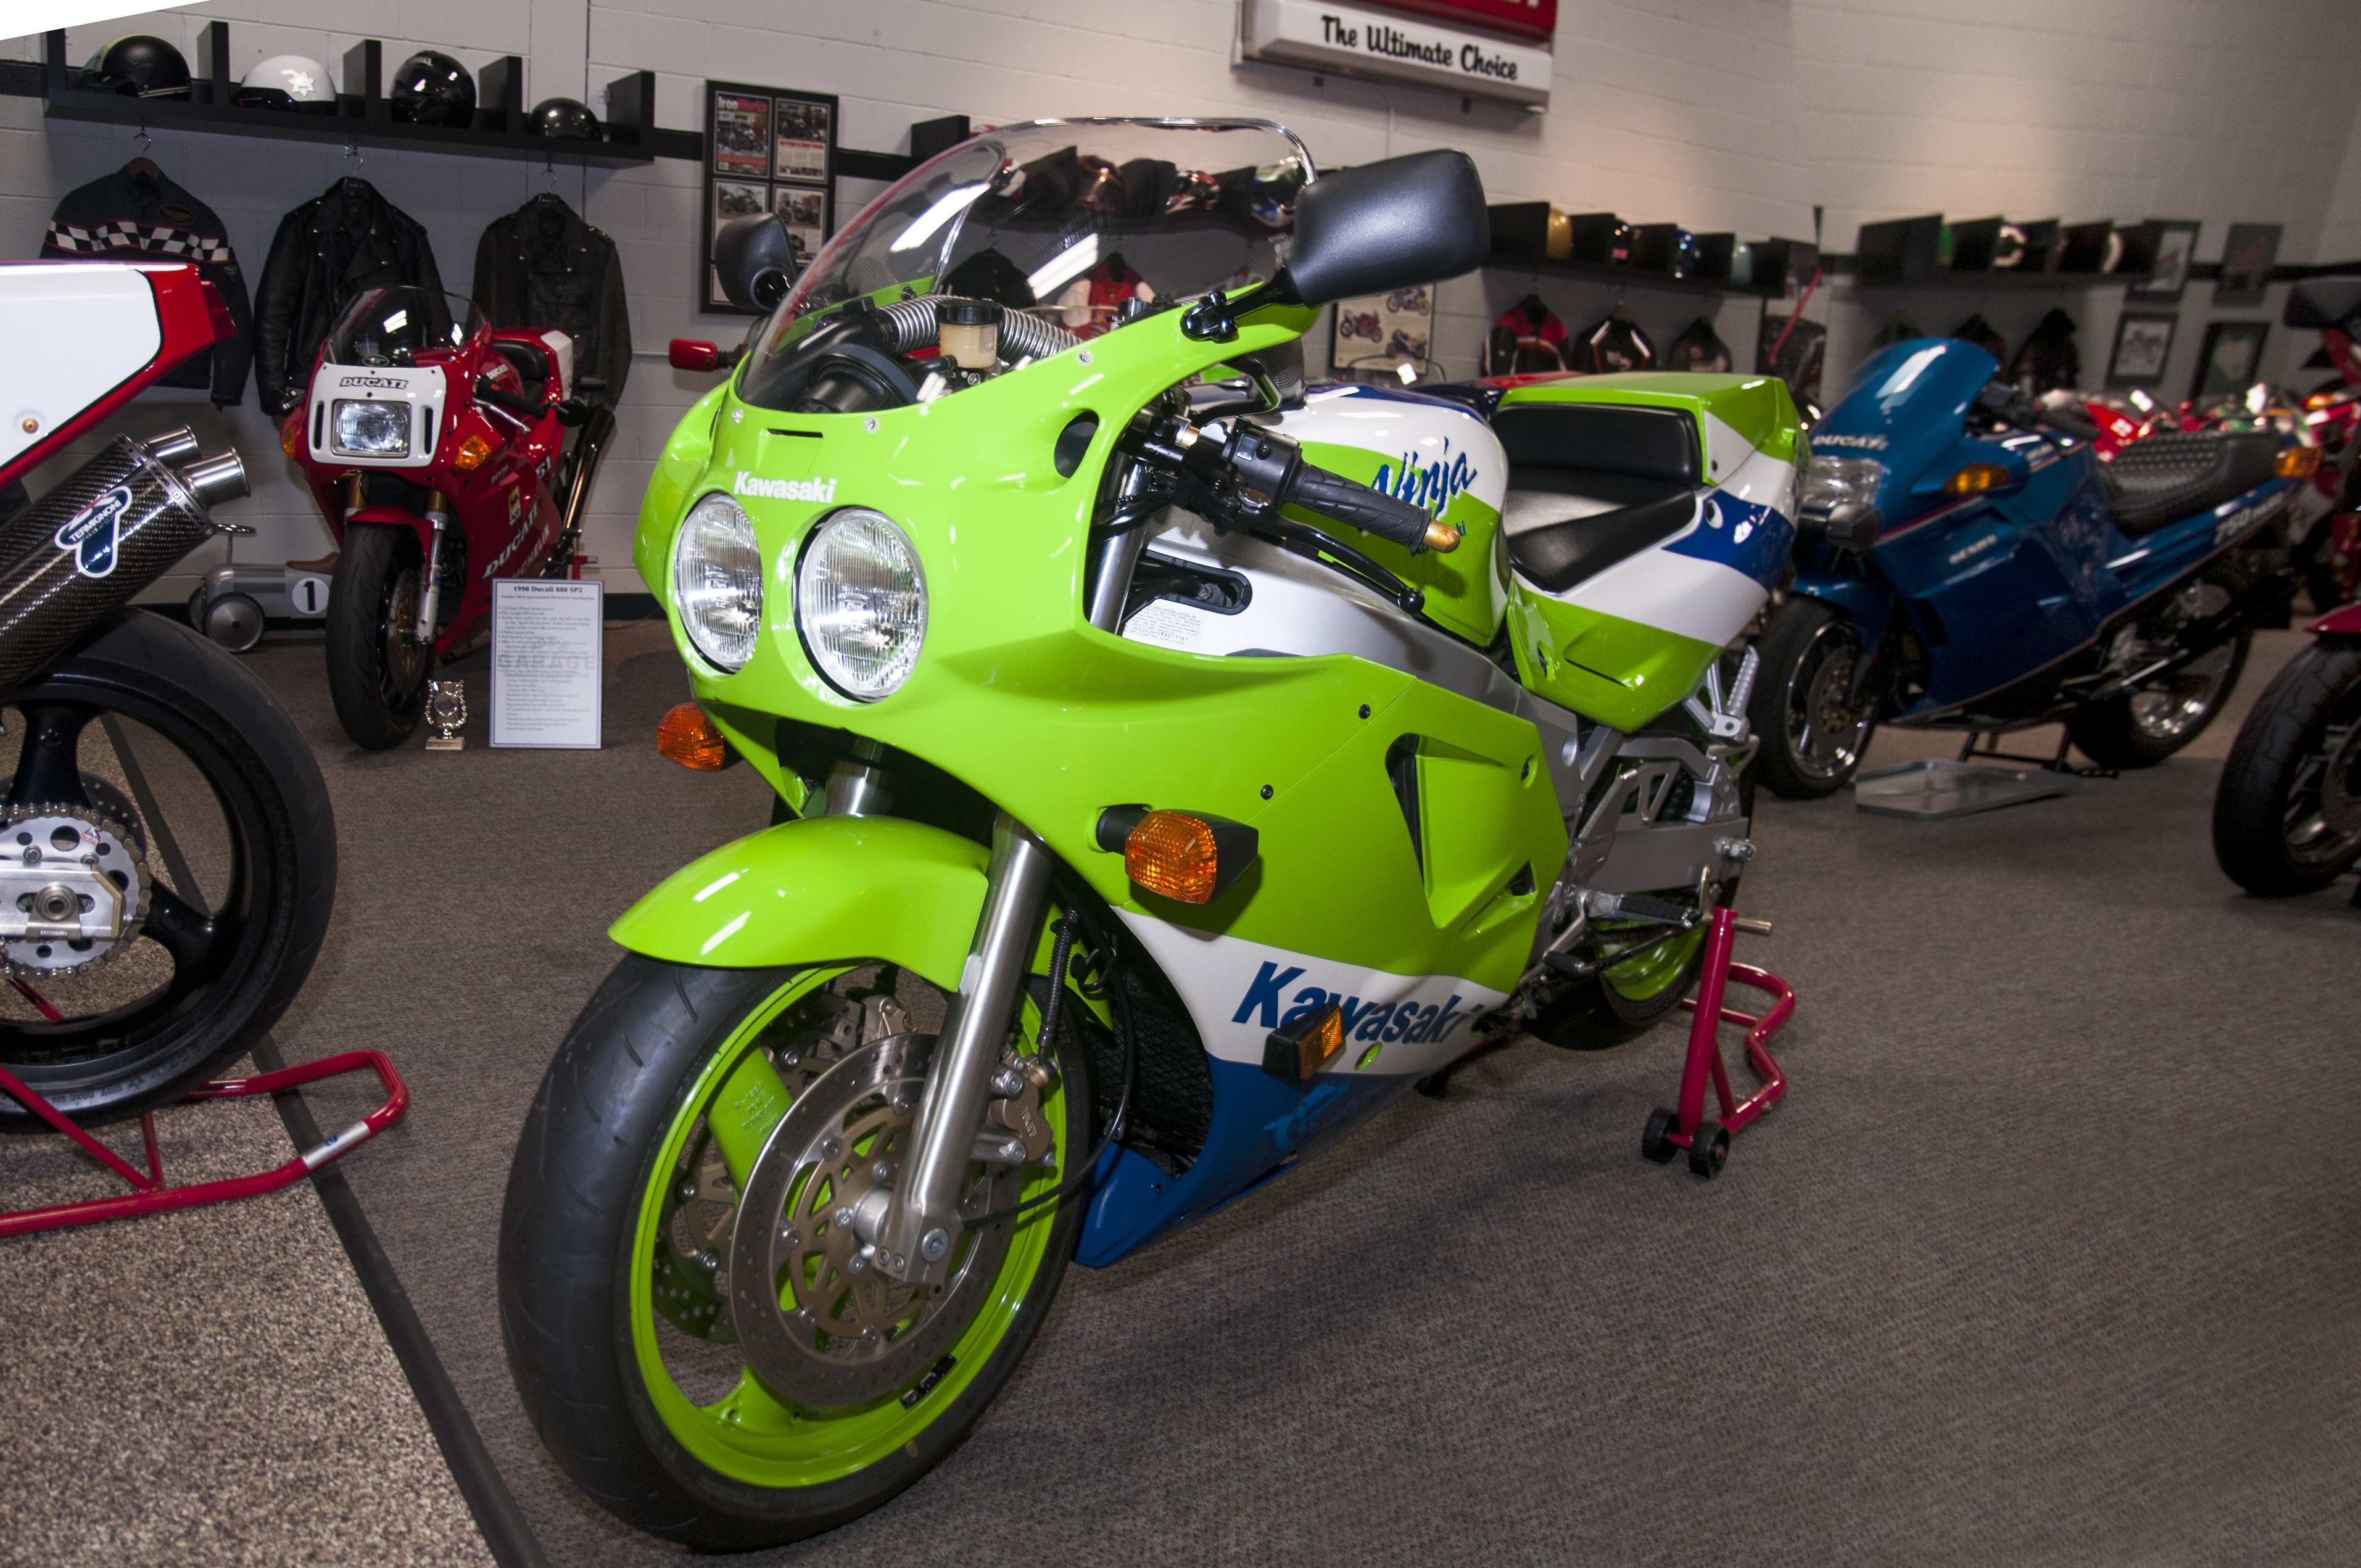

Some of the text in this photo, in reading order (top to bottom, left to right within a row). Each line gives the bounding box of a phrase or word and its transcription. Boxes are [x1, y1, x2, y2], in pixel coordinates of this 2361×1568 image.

[1321, 15, 1518, 81] The Ultimate Choice
[339, 377, 409, 390] DUCATI
[535, 455, 552, 479] 51
[734, 471, 837, 504] Kawasaki
[1371, 435, 1478, 519] Ninja
[68, 500, 122, 542] TERMIGNONI
[482, 501, 538, 579] DUCATI
[303, 580, 316, 611] 1
[1231, 960, 1485, 1044] Kawasaki
